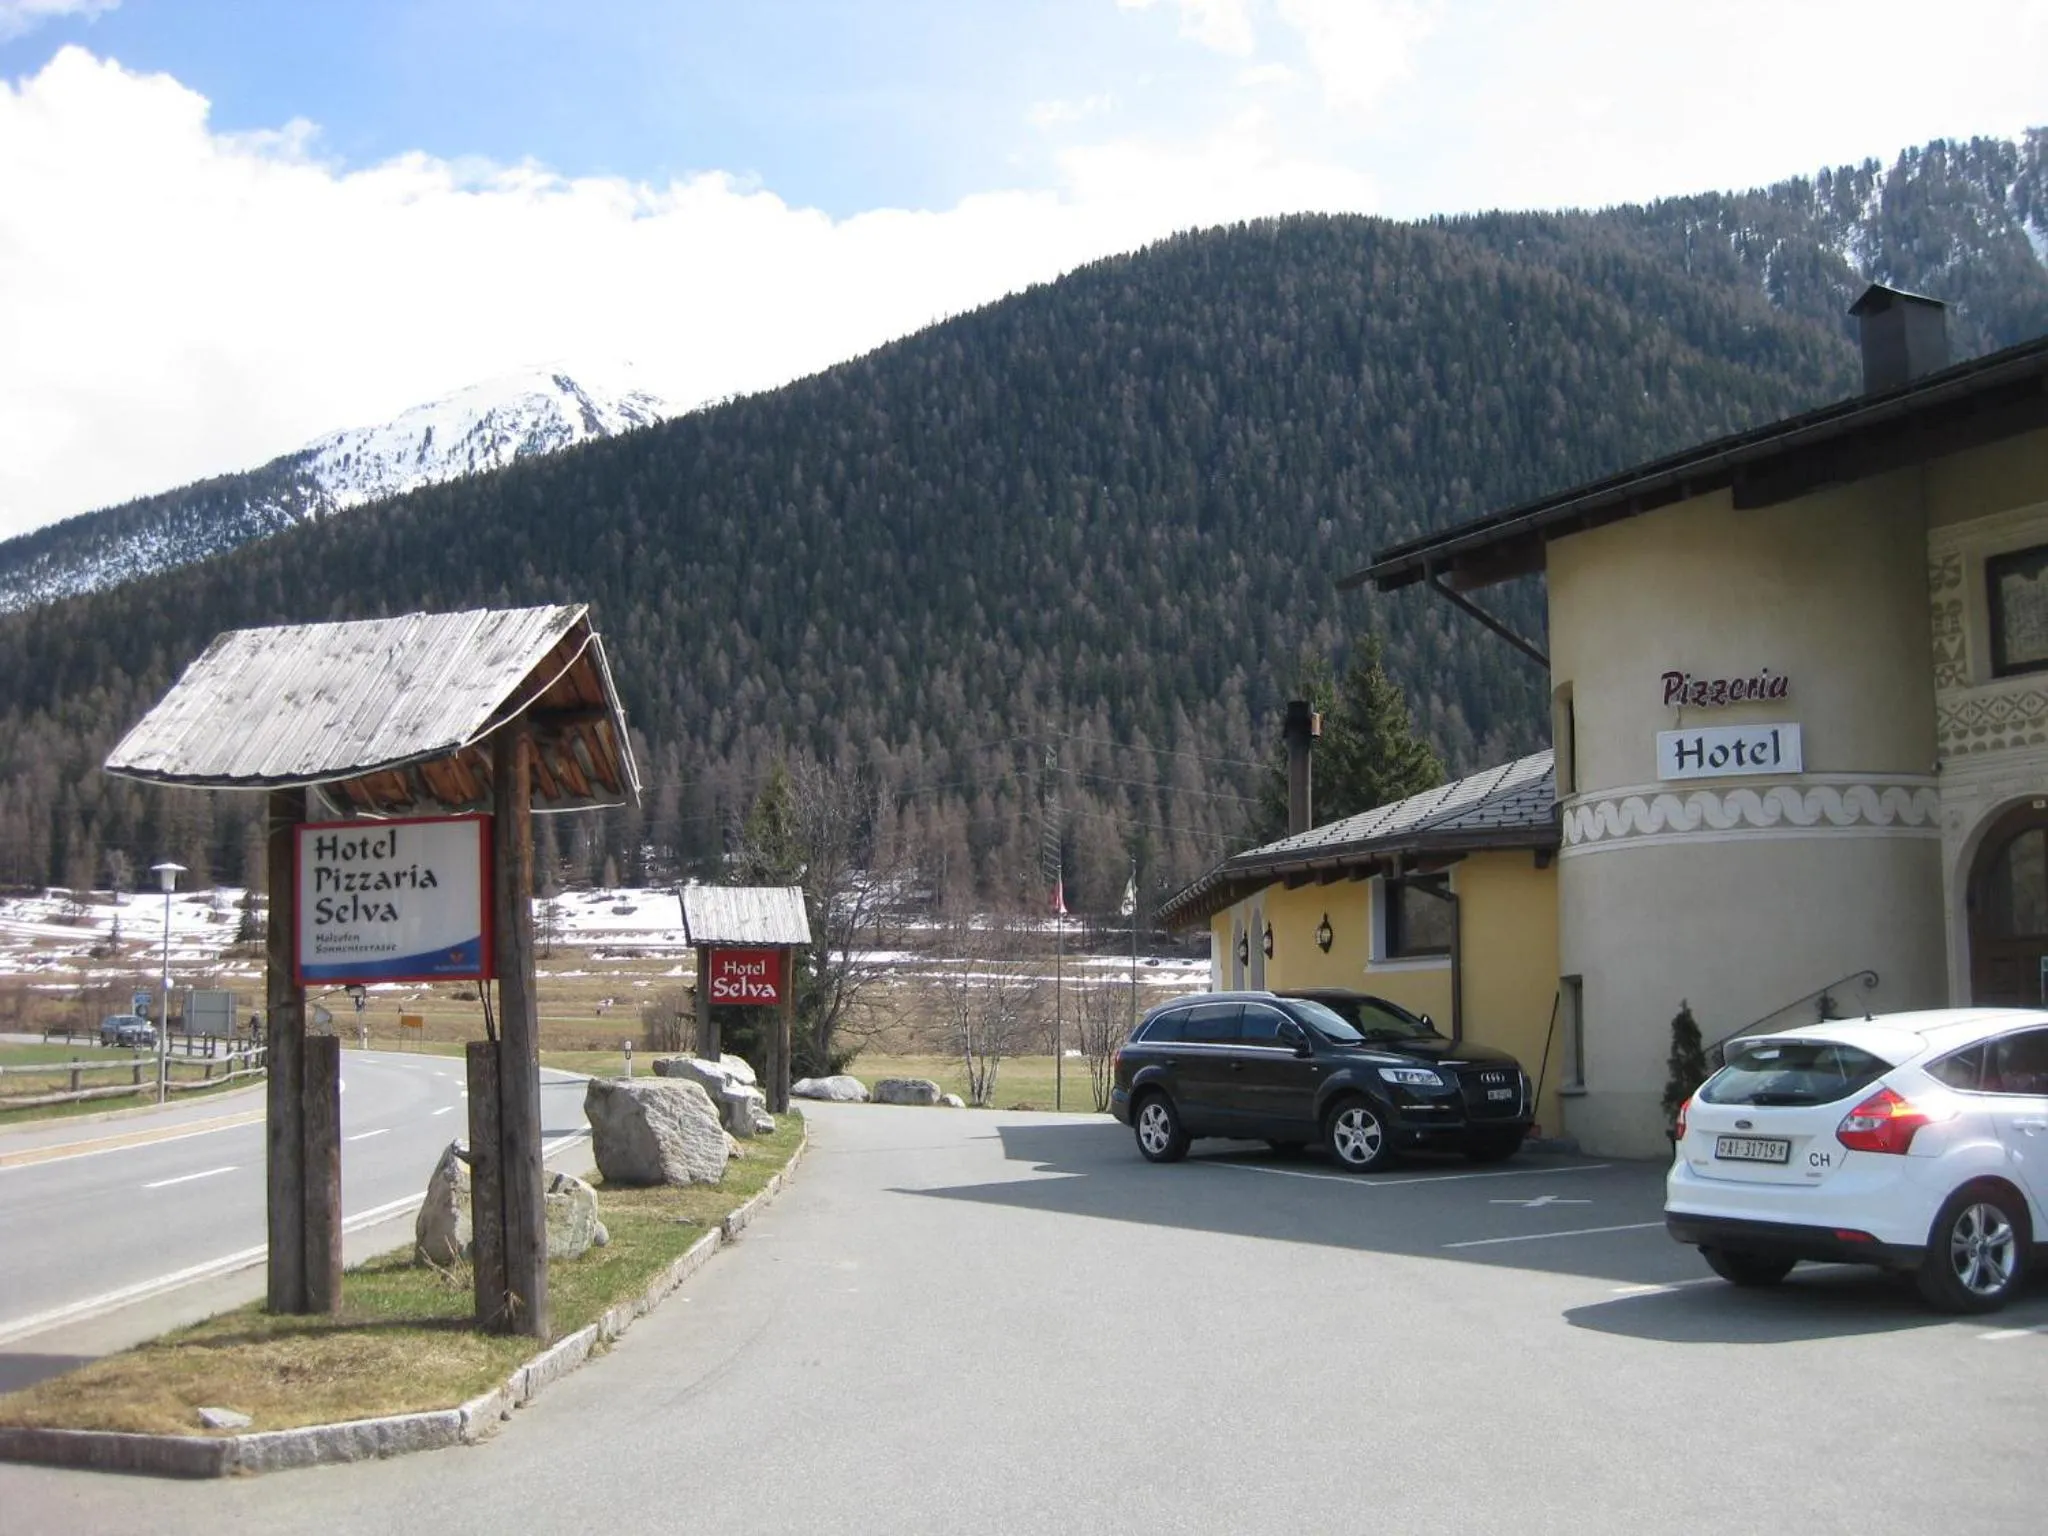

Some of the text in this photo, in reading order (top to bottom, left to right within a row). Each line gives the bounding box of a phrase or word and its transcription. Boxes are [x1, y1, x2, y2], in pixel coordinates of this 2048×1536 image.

[1661, 668, 1788, 706] Pizzeria
[1675, 729, 1780, 770] Hotel
[315, 829, 396, 861] Hotel
[314, 864, 438, 893] Pizzaria
[315, 894, 399, 925] Selva
[724, 960, 766, 976] Hotel
[713, 975, 777, 997] Selva
[1809, 1153, 1831, 1167] CH
